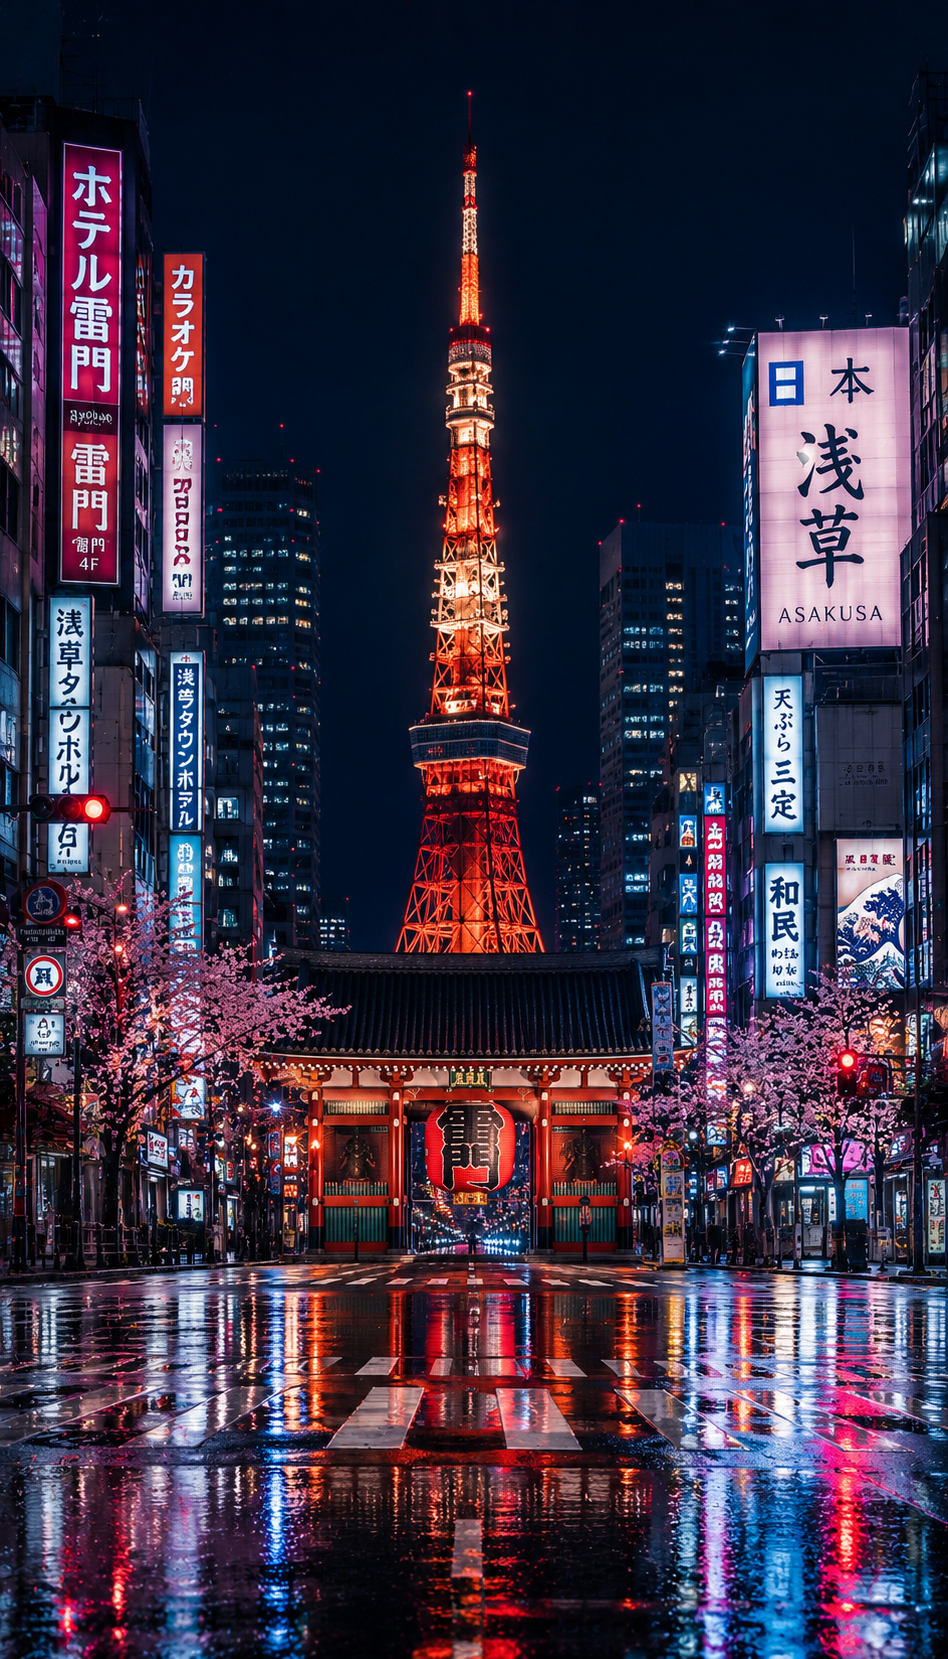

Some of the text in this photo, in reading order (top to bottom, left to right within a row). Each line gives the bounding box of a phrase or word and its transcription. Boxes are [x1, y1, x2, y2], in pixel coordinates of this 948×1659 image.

[71, 165, 113, 393] ホテル雷門
[768, 358, 875, 407] 日本
[71, 442, 110, 532] 雷門
[796, 423, 865, 589] 浅草
[79, 557, 100, 571] 4F
[778, 605, 883, 624] ASAKUSA
[769, 876, 800, 943] 和民
